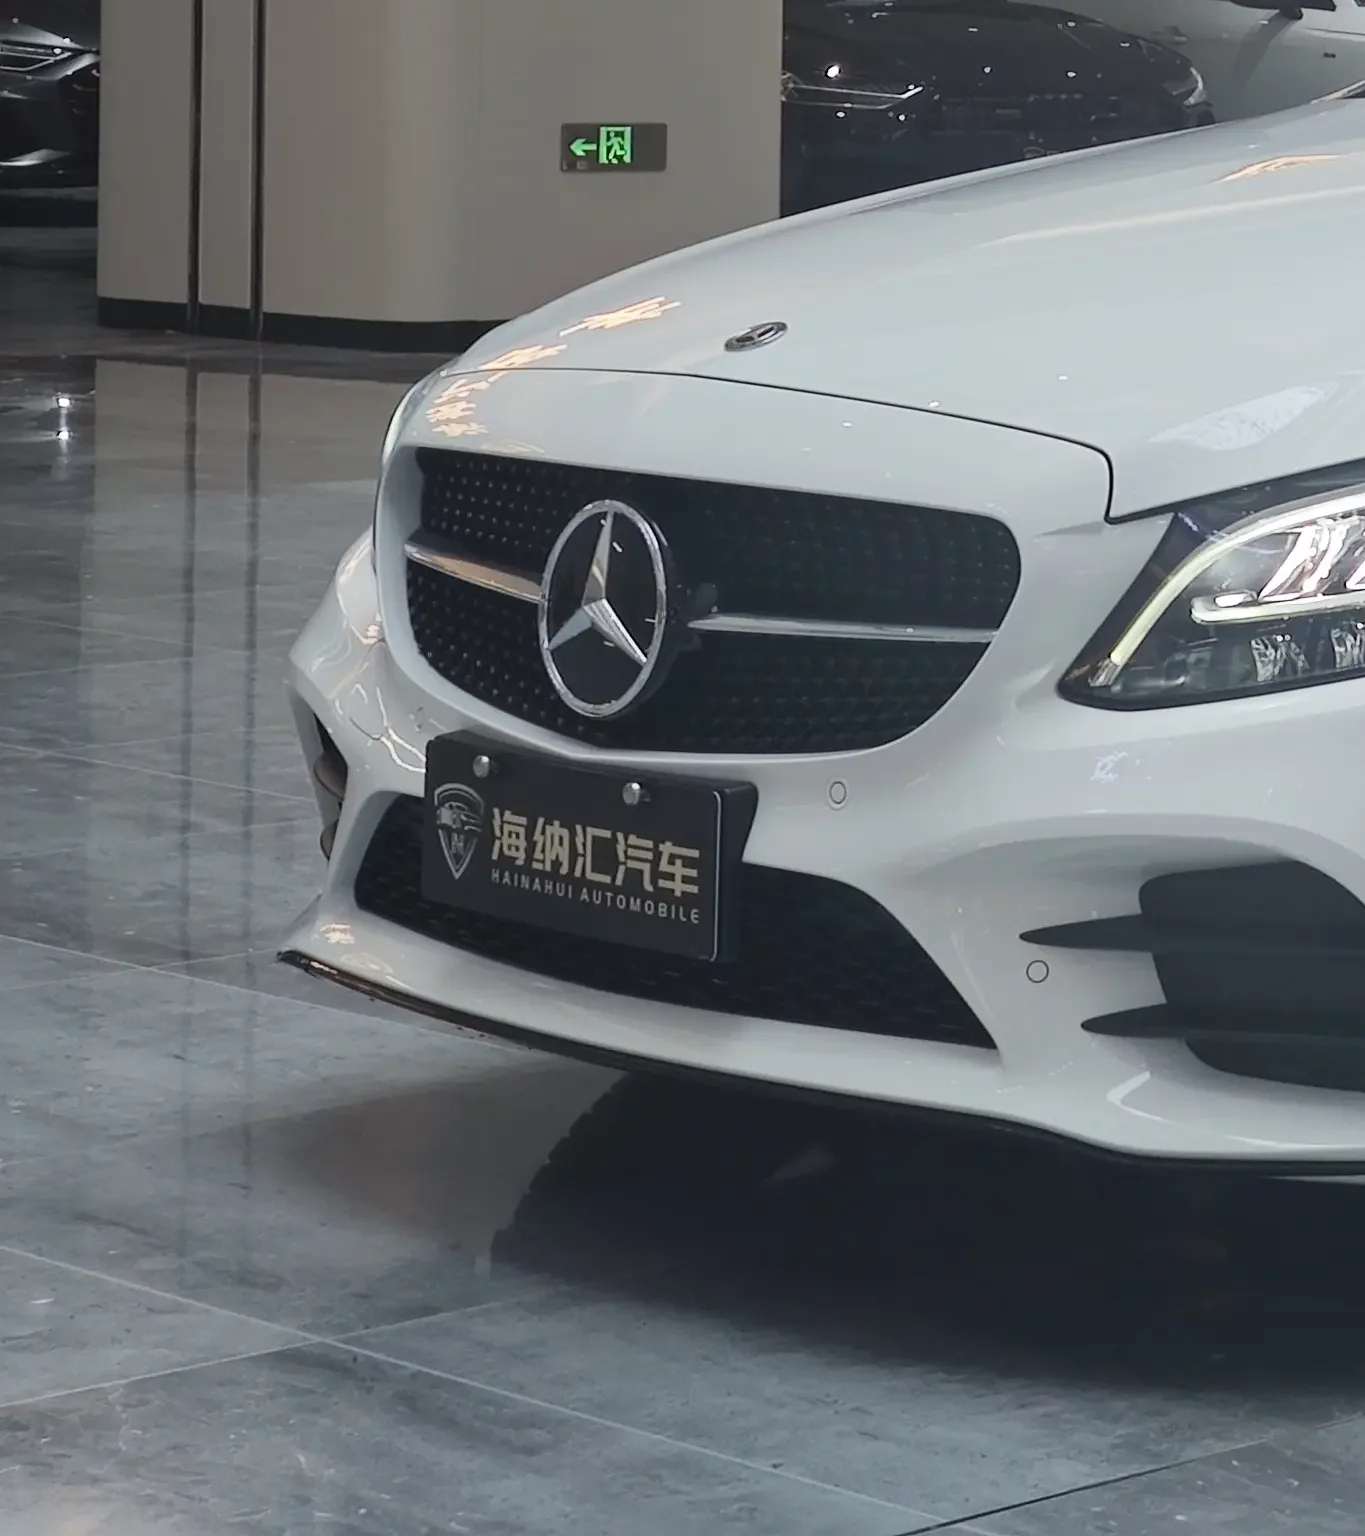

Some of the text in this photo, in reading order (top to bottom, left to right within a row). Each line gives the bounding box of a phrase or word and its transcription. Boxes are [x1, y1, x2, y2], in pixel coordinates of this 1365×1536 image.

[491, 807, 700, 898] 海纳汇汽车
[491, 868, 700, 924] HAINAHUI AUTOMOBILE
